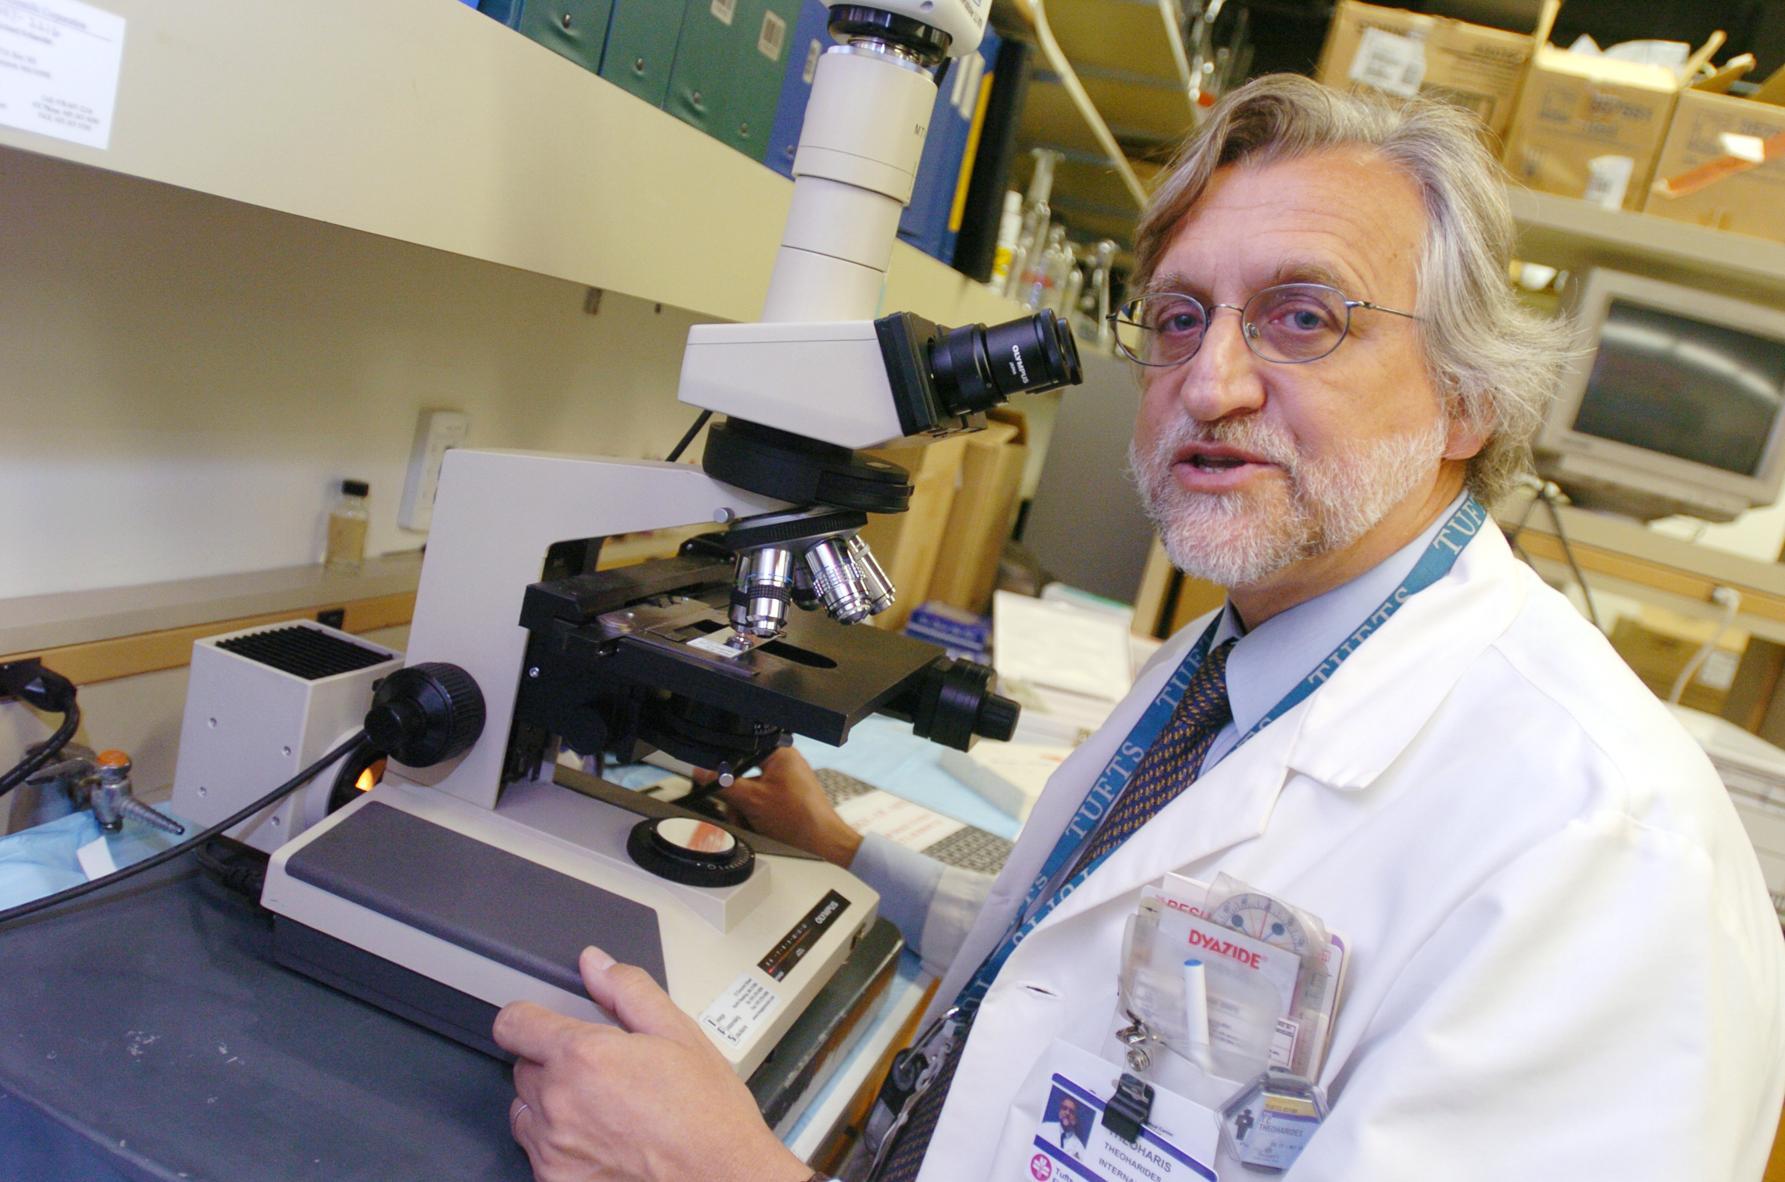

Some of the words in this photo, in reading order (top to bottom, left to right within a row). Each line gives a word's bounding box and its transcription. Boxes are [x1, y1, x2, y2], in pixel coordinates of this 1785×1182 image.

[1012, 344, 1029, 384] OLYMPUS
[1432, 497, 1485, 556] TUF
[1065, 740, 1145, 840] TUFTS
[1187, 928, 1262, 970] DYAZIDE
